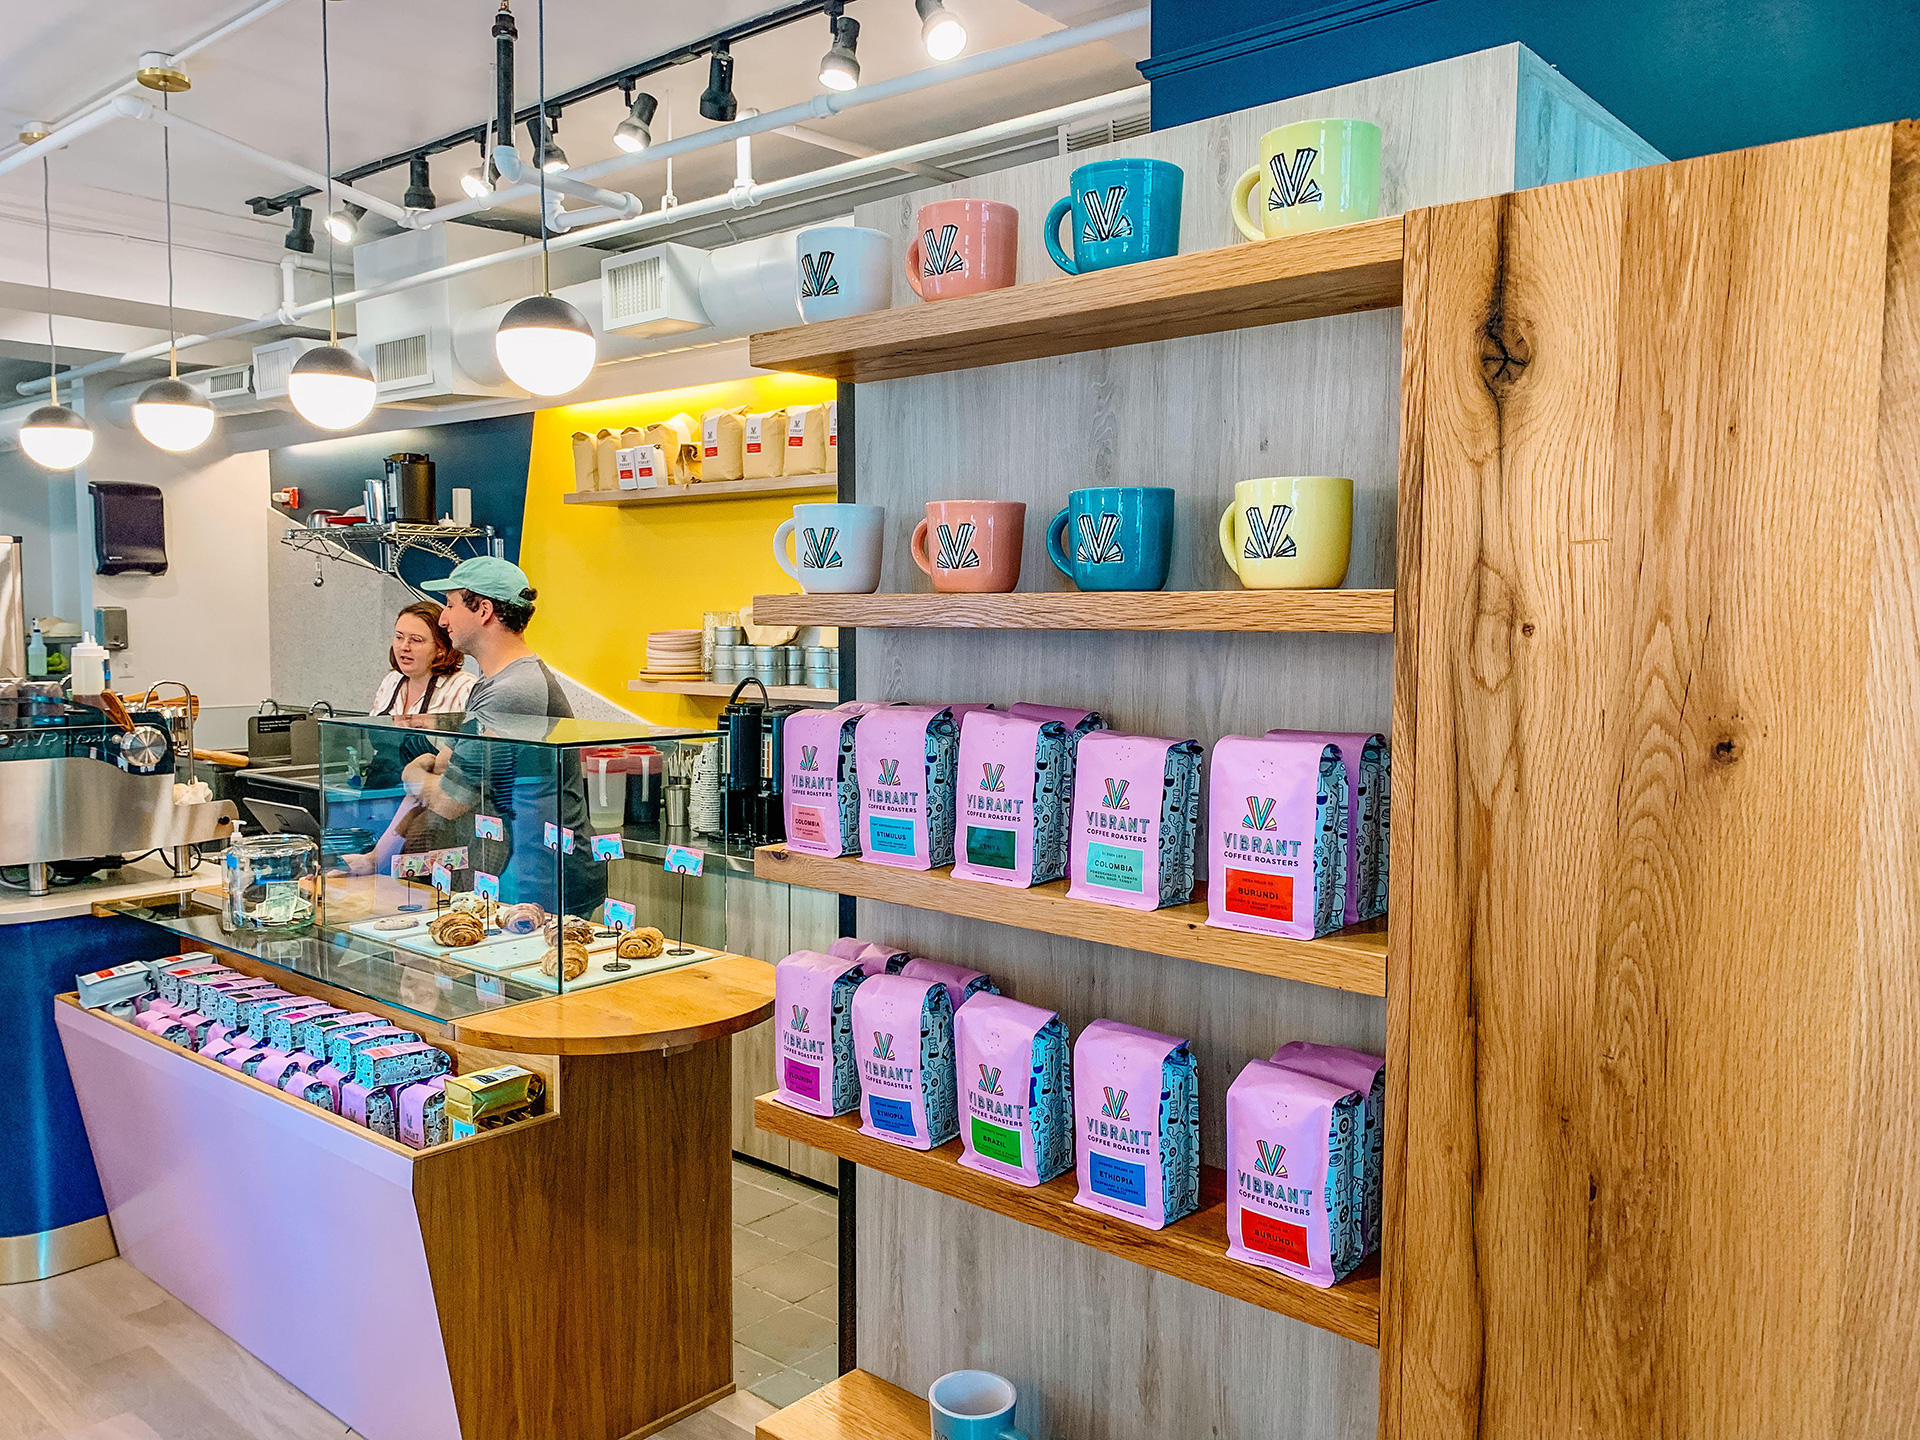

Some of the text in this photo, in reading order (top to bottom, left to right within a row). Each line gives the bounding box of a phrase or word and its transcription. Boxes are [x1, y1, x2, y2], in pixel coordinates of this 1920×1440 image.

[792, 774, 834, 790] VIBRANT
[867, 788, 918, 805] VIBRANT
[967, 794, 1023, 814] VIBRANT
[795, 818, 820, 827] COLOMBIA
[988, 814, 1021, 822] ROASTERS
[1086, 810, 1150, 834] VIBRANT
[877, 831, 906, 840] STIMULUS
[1087, 828, 1147, 843] COFFEE ROASTERS
[1223, 831, 1302, 857] VIBRANT
[1095, 860, 1134, 872] COLOMBIA
[1224, 851, 1299, 867] COFFEE ROASTERS
[1238, 887, 1278, 900] BURUNDI
[783, 1030, 825, 1054] VIBRANT
[864, 1059, 913, 1082] VIBRANT
[883, 1080, 913, 1090] ROASTERS
[968, 1089, 1023, 1119] VIBRANT
[877, 1110, 904, 1120] ETHIOPIA
[969, 1105, 1023, 1127] COFFEE ROASTERS
[1086, 1116, 1152, 1147] VIBRANT
[983, 1135, 1007, 1148] BRAZIL
[1088, 1134, 1150, 1155] COFFEE ROASTERS
[1100, 1170, 1134, 1186] ETHIOPIA
[1238, 1169, 1312, 1206] VIBRANT
[1239, 1189, 1310, 1216] COFFEE ROASTERS
[1254, 1229, 1294, 1246] BURUNDI
